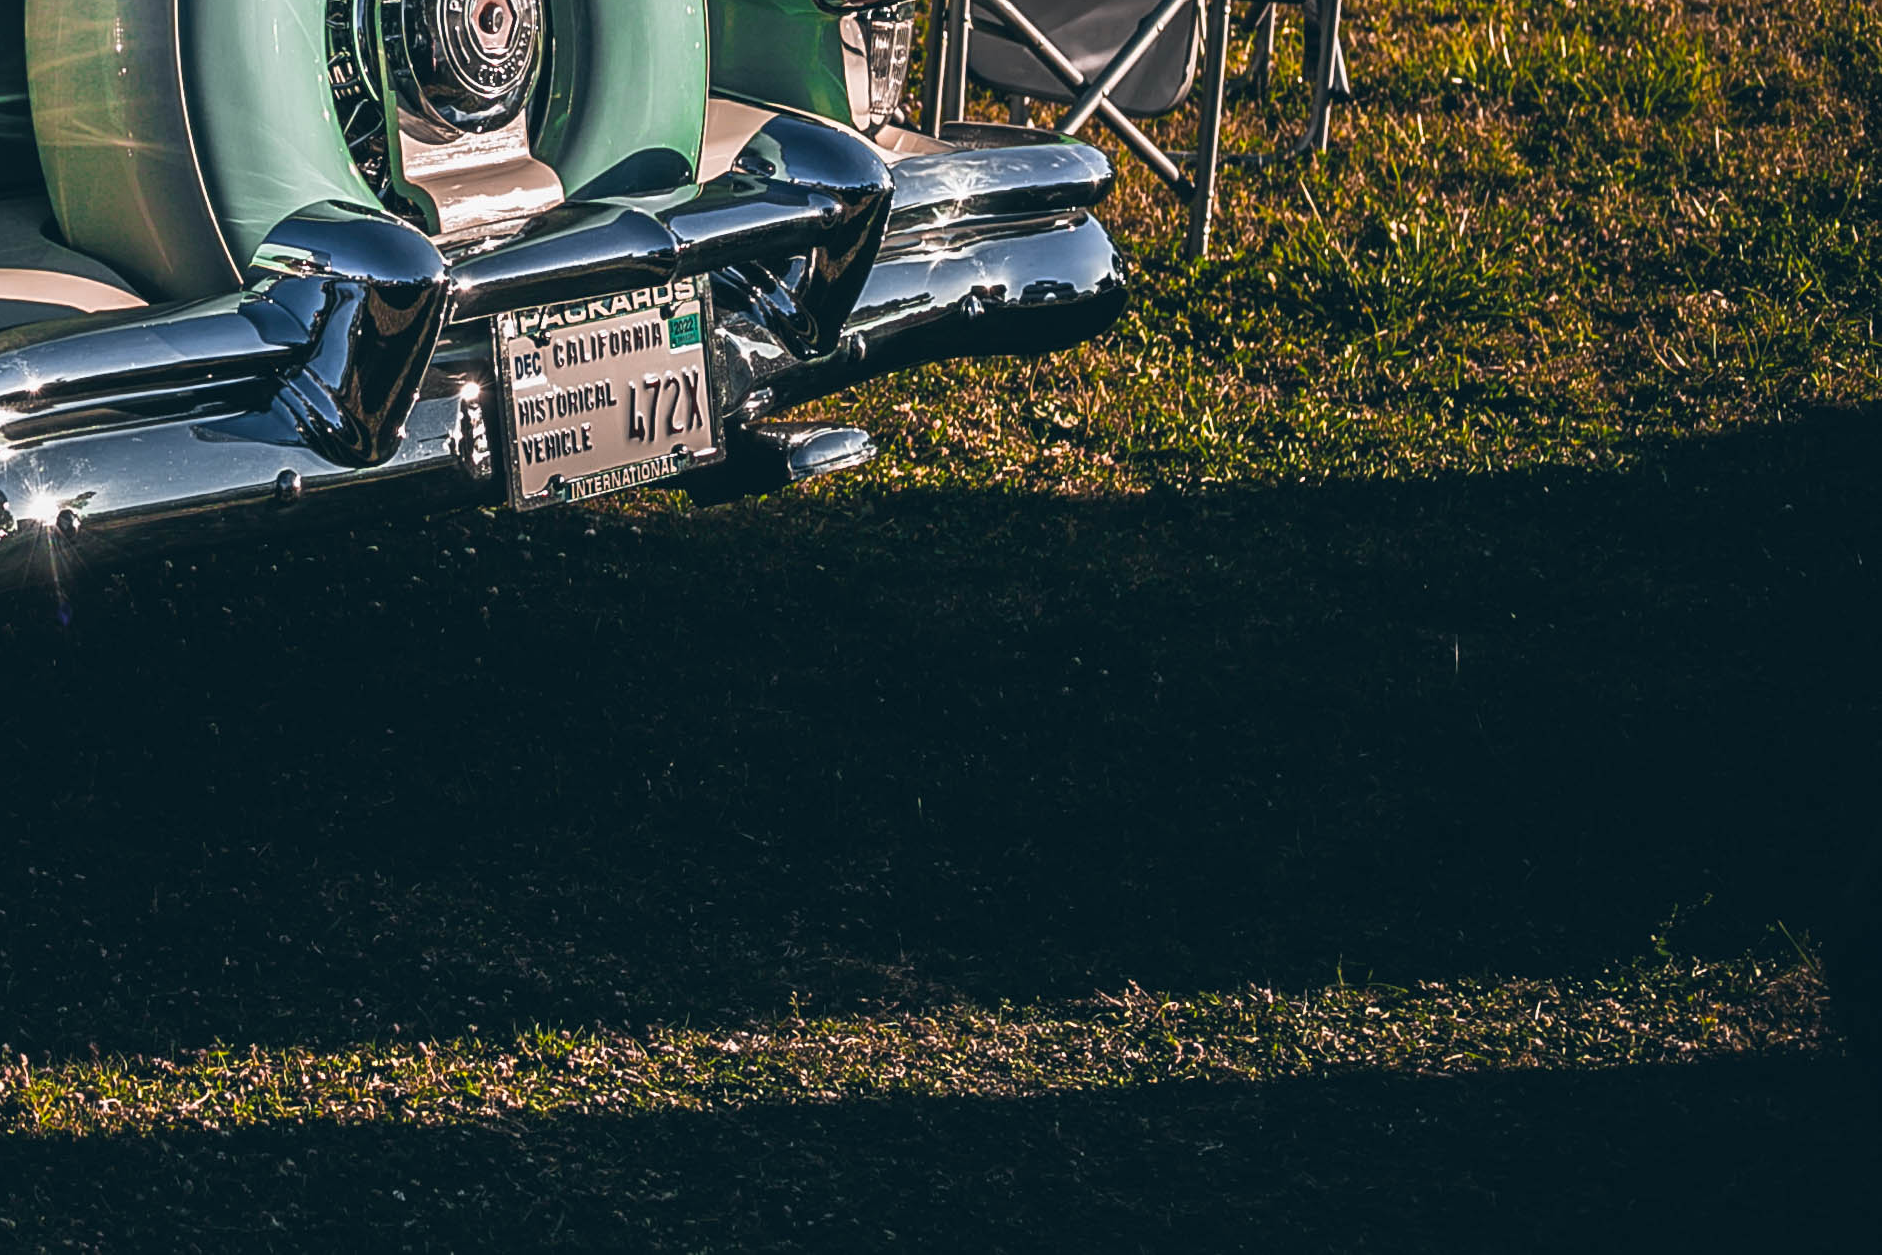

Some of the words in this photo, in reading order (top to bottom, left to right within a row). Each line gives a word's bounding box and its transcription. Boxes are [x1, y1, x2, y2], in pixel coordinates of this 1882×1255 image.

[519, 279, 696, 334] PACKARDS
[673, 317, 694, 335] 2022
[514, 351, 543, 380] DEC
[552, 318, 664, 369] CALIFORNIA
[518, 378, 618, 426] HISTORICAL
[627, 364, 704, 443] 472X
[521, 421, 593, 466] VEHICLE
[570, 457, 678, 500] INTERNATIONAL
